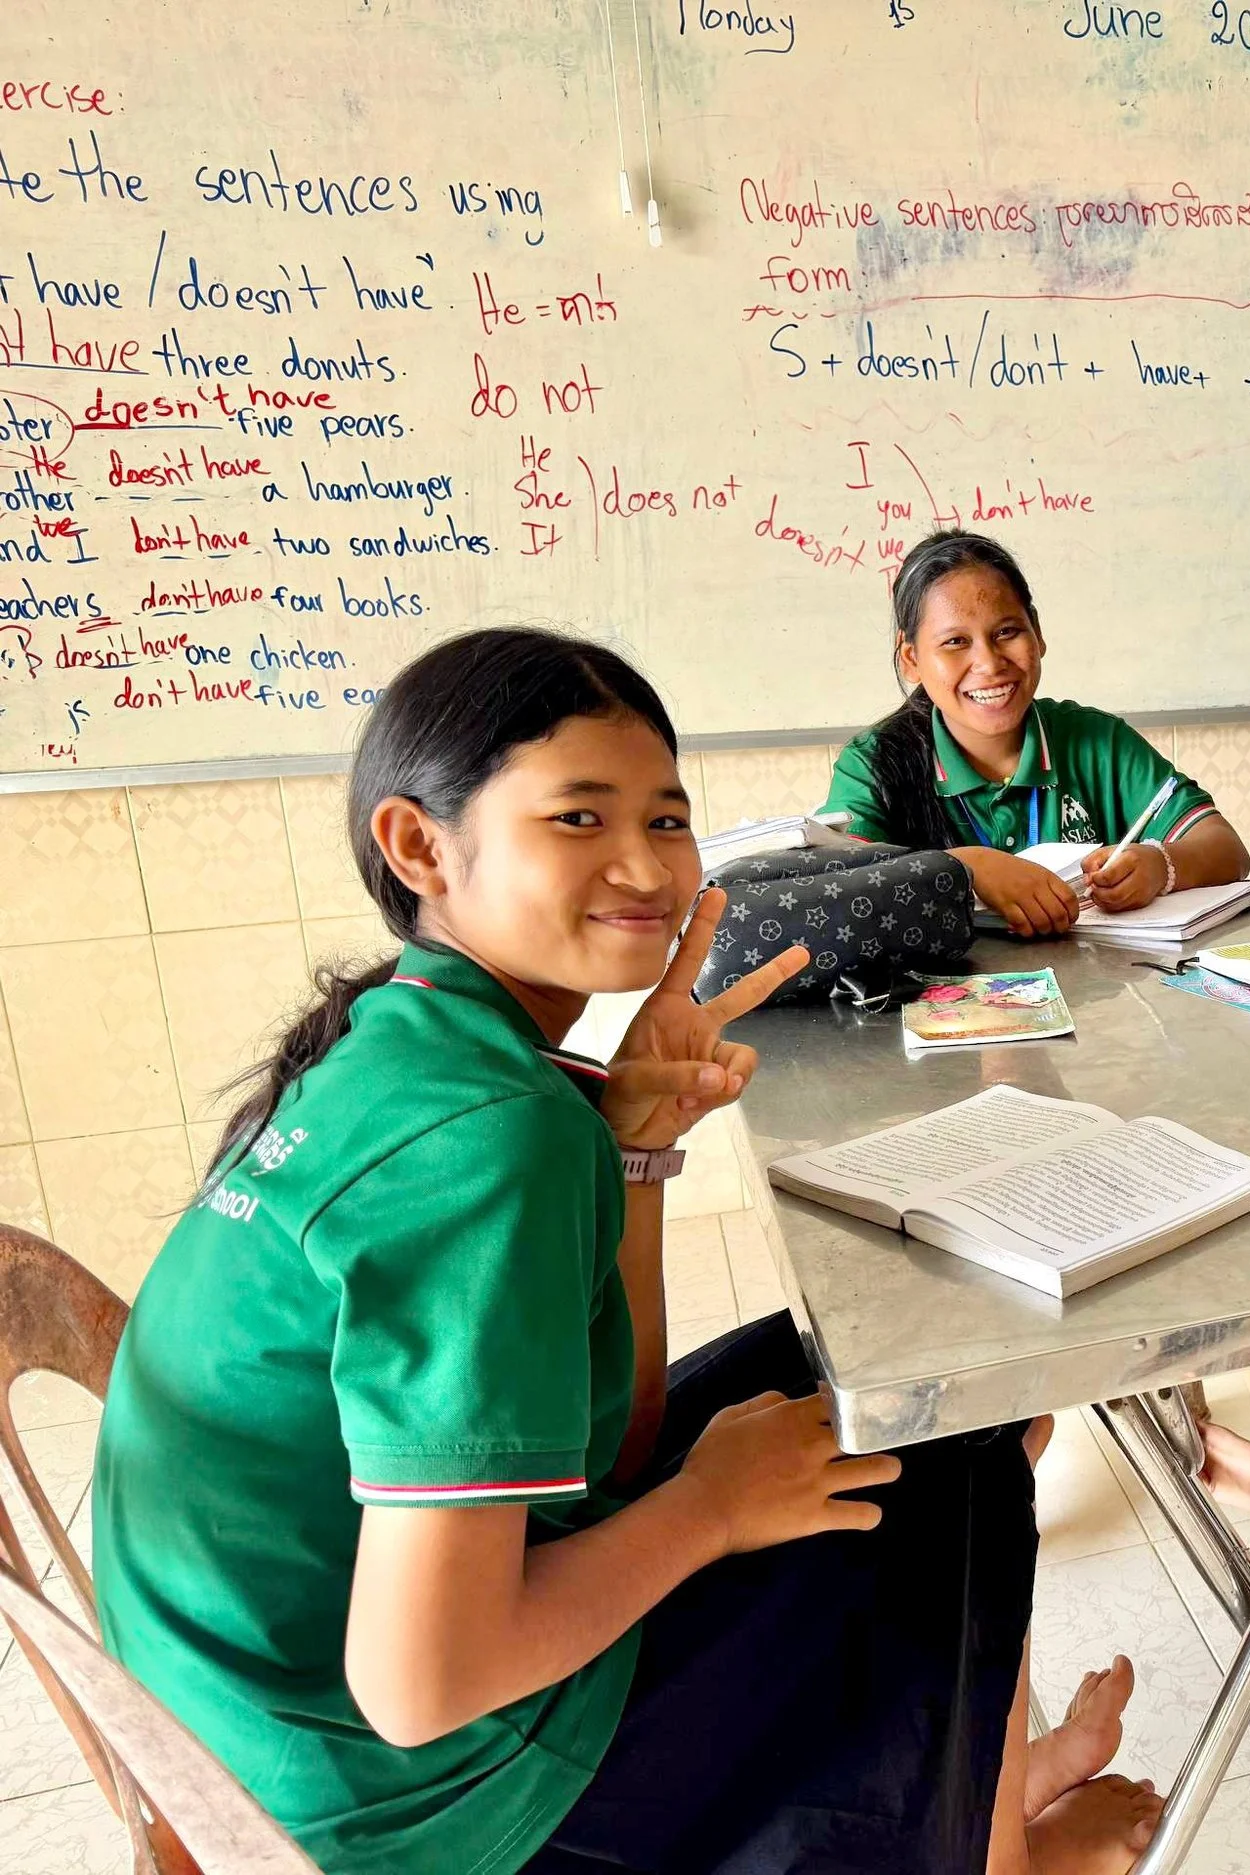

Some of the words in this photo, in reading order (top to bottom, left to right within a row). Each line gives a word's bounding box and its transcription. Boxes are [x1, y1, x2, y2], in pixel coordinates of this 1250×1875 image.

[1064, 0, 1163, 38] June
[0, 82, 124, 115] ercise:
[59, 130, 148, 202] the
[195, 149, 418, 214] sentences
[449, 184, 543, 245] using
[741, 178, 880, 247] Negative
[28, 252, 122, 308] have
[473, 272, 526, 335] He
[47, 307, 139, 372] have
[152, 328, 252, 378] three
[770, 323, 806, 378] S
[248, 383, 337, 410] have
[471, 352, 517, 419] do
[543, 363, 603, 415] not
[237, 407, 294, 438] five
[30, 445, 77, 480] He
[521, 435, 551, 472] He
[846, 442, 874, 489] I
[201, 445, 271, 479] have
[262, 482, 288, 502] a
[514, 471, 571, 509] She
[603, 466, 677, 517] does
[693, 474, 743, 509] not
[877, 500, 911, 530] you
[1038, 478, 1095, 514] have
[0, 530, 52, 562] nd
[67, 529, 99, 563] I
[189, 514, 251, 551] have
[273, 527, 330, 556] two
[520, 522, 562, 556] It
[205, 579, 263, 607] have
[139, 627, 188, 657] have
[185, 645, 231, 665] one
[188, 669, 254, 701] have
[254, 685, 326, 709] five
